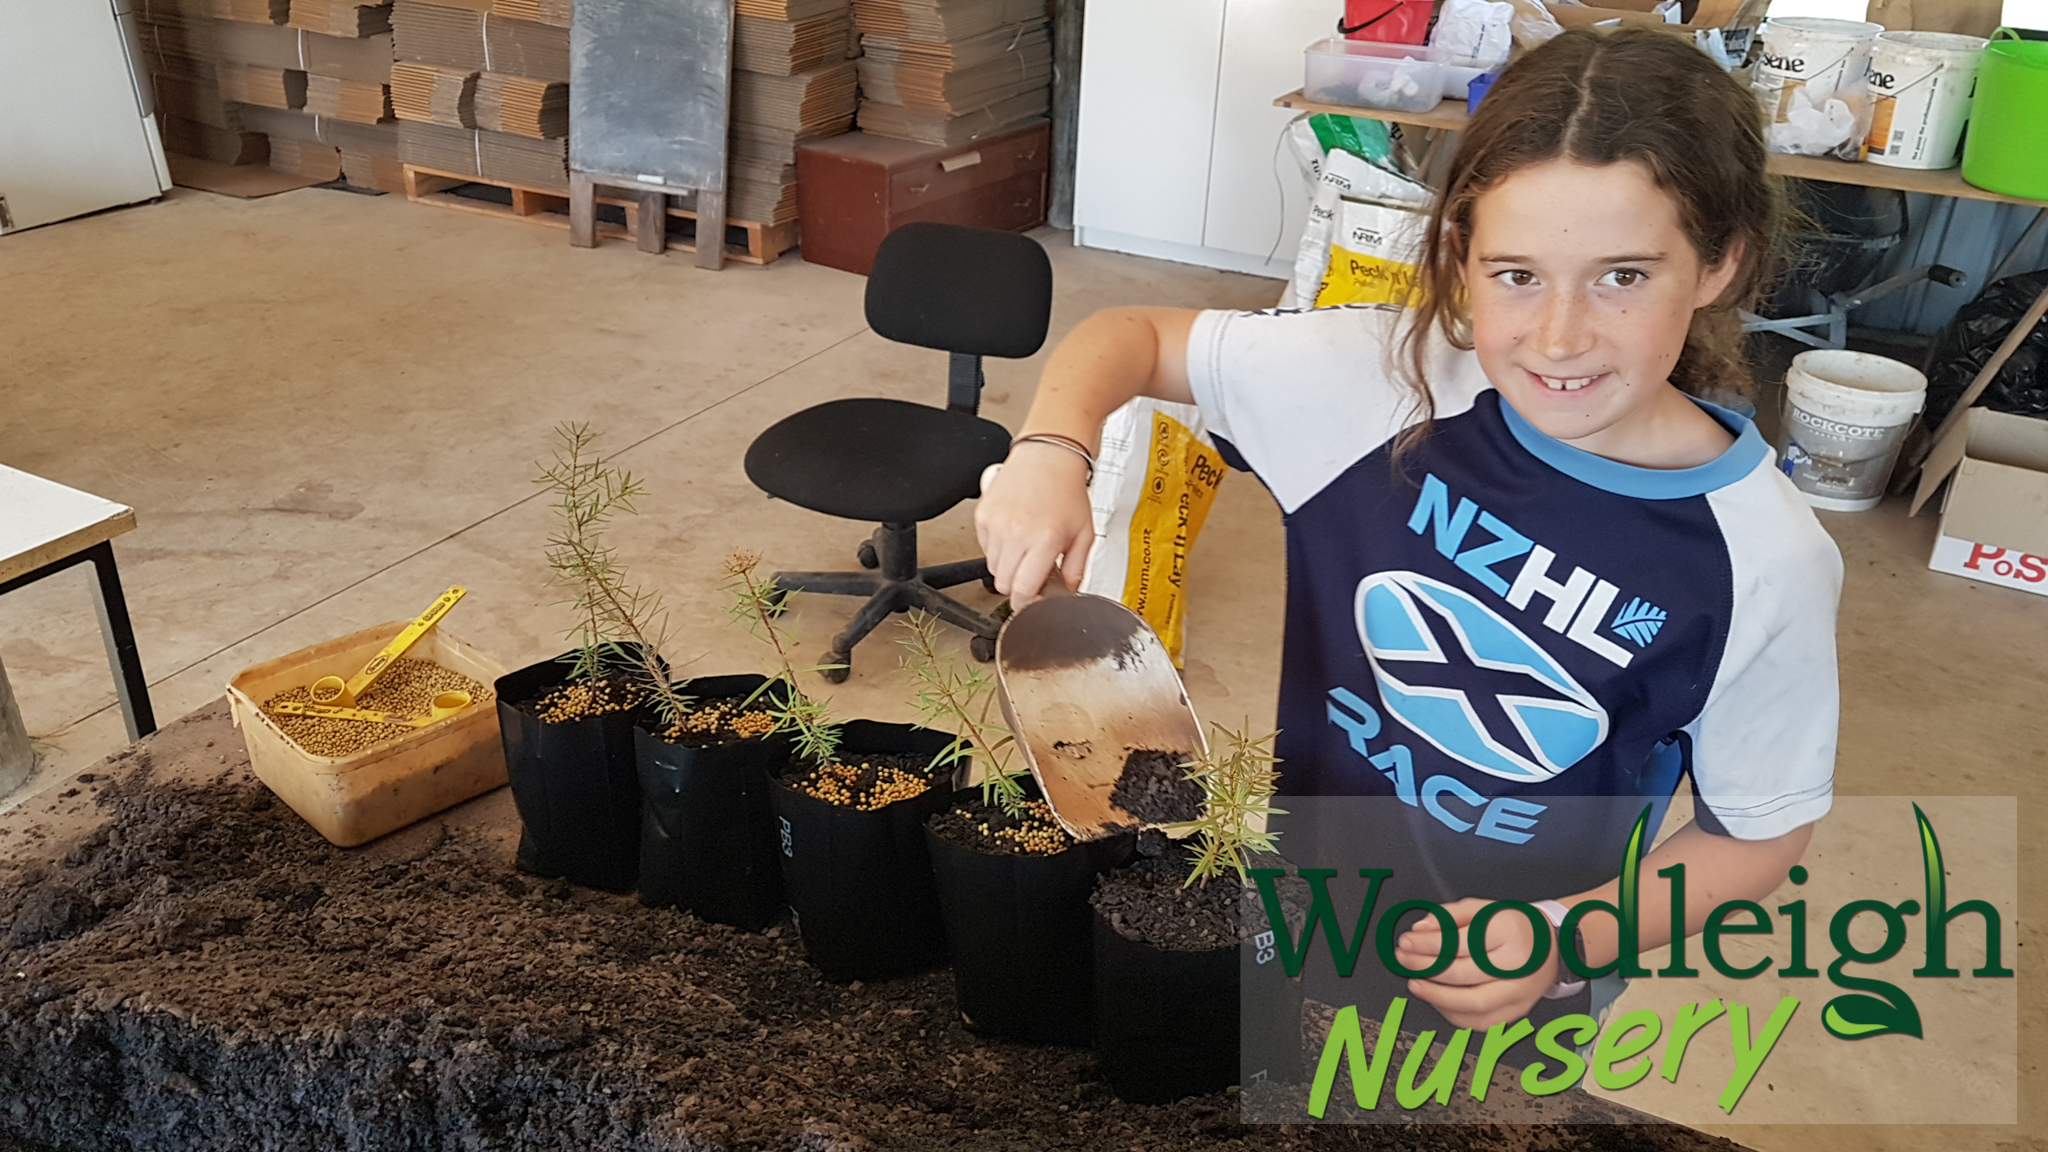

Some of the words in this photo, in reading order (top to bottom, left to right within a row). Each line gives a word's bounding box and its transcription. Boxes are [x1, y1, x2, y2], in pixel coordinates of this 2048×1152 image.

[1352, 230, 1383, 246] NRM
[1349, 259, 1390, 282] Peck
[1792, 407, 1884, 438] ROCKCOTE
[1407, 472, 1635, 669] NZHL
[1325, 686, 1549, 845] RACE
[778, 816, 793, 858] PB3
[1254, 930, 1277, 966] B3
